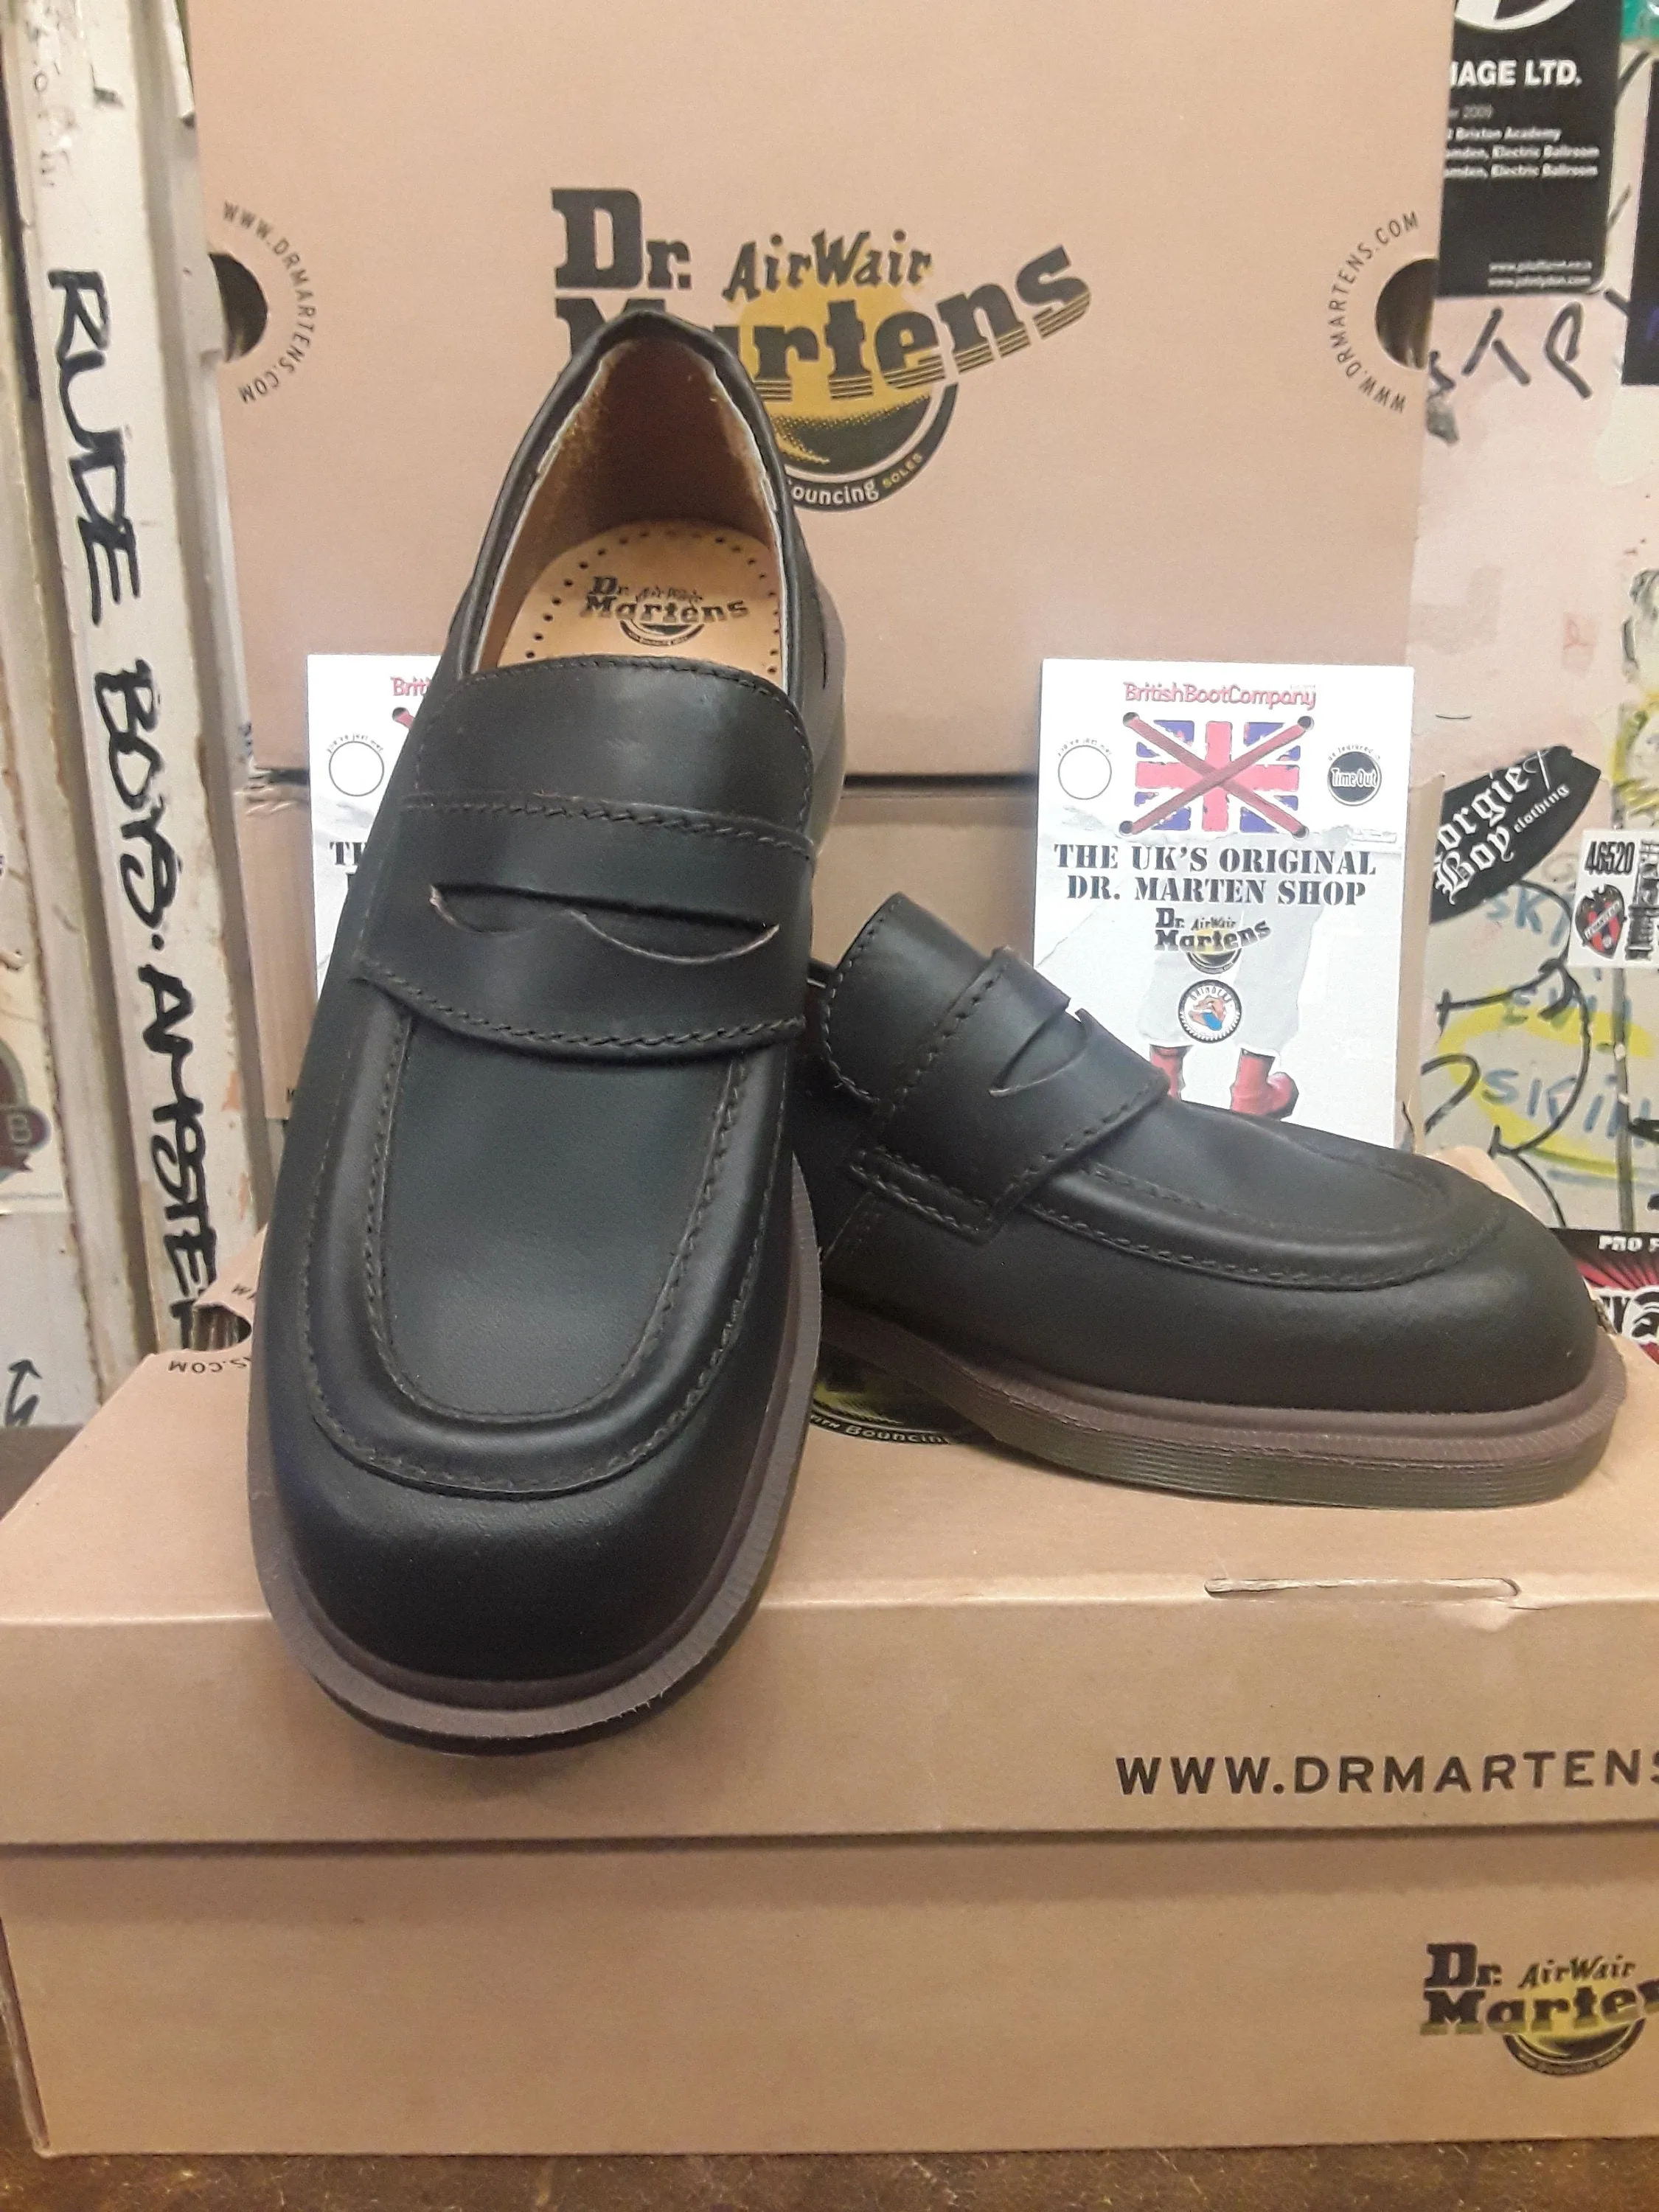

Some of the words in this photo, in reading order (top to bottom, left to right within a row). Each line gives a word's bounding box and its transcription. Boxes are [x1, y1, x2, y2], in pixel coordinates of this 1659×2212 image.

[1524, 59, 1583, 86] LTD.
[551, 187, 693, 290] Dr.
[721, 229, 933, 303] AirWair
[47, 268, 142, 628] RUDE
[787, 479, 880, 506] ouncing
[581, 594, 749, 624] Martens
[1436, 764, 1530, 852] orgie
[1054, 843, 1119, 869] THE
[1130, 845, 1208, 872] UK'S
[1219, 848, 1377, 876] ORIGINAL
[1433, 824, 1515, 906] Boy
[1513, 782, 1571, 834] clothing
[1585, 841, 1635, 875] 46520
[1067, 874, 1121, 900] DR.
[1134, 876, 1267, 904] MARTEN
[1277, 880, 1366, 906] SHOP
[1153, 919, 1273, 952] Martens
[1155, 907, 1186, 929] Dr.
[1116, 1747, 1659, 1795] WWW.DRMARTEN
[1423, 1941, 1503, 1989] Dr.
[1517, 1954, 1636, 1990] AirWair
